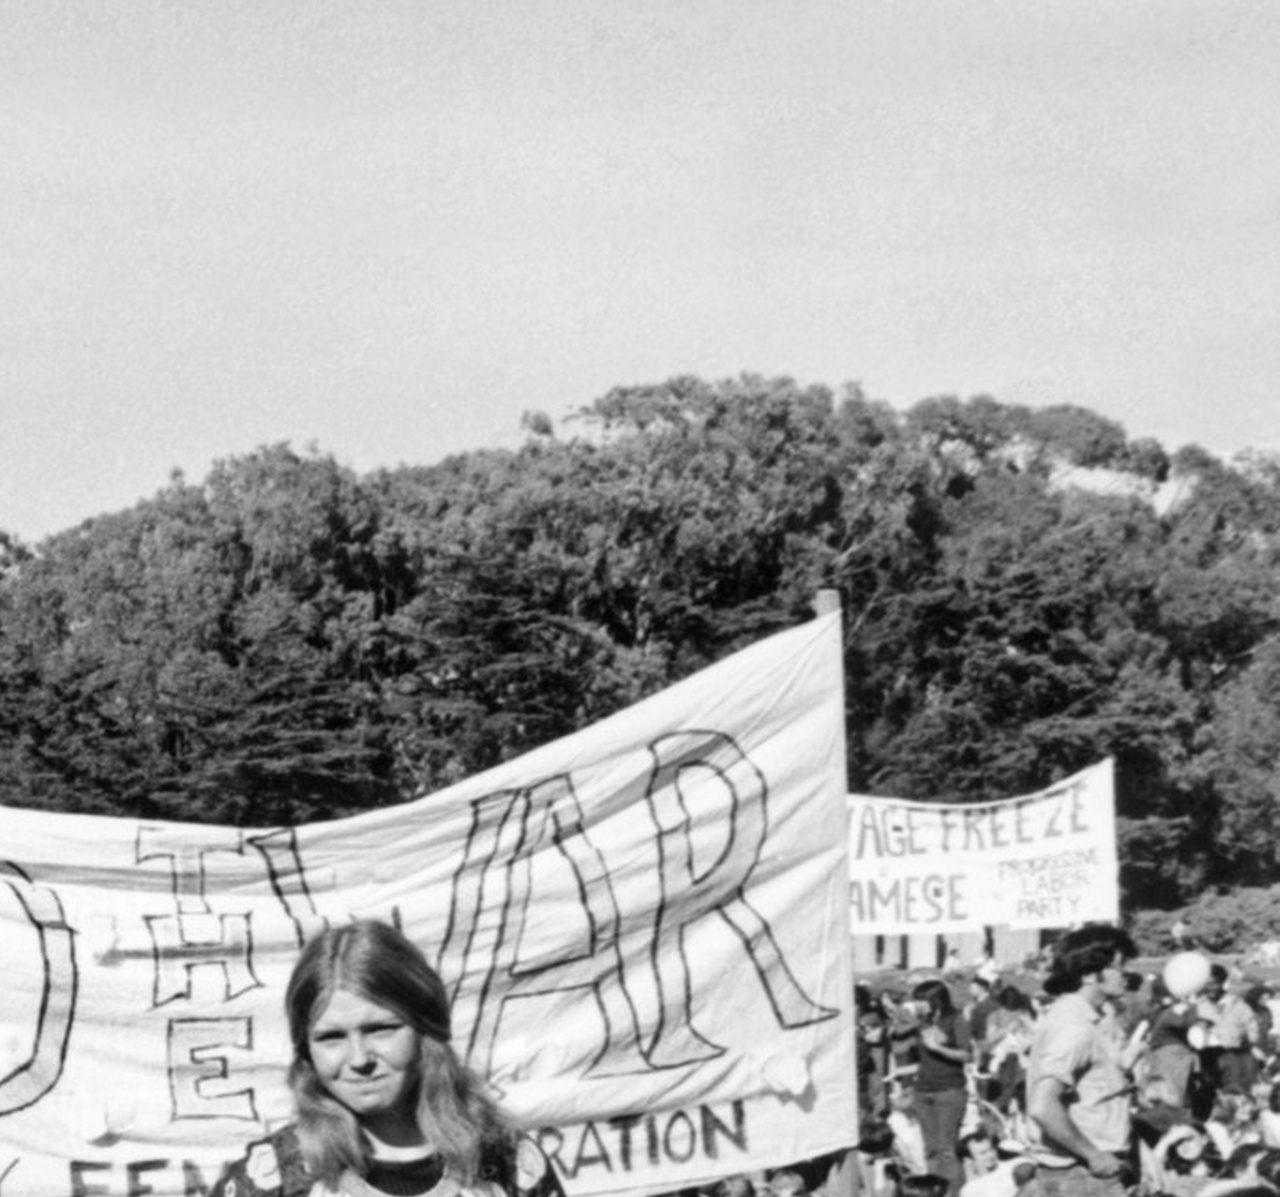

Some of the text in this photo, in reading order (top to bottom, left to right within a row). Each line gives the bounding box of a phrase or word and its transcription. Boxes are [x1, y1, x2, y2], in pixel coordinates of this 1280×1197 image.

[846, 783, 1090, 859] AGE FREEZE
[1017, 895, 1082, 918] PARTY
[135, 825, 266, 1122] THE
